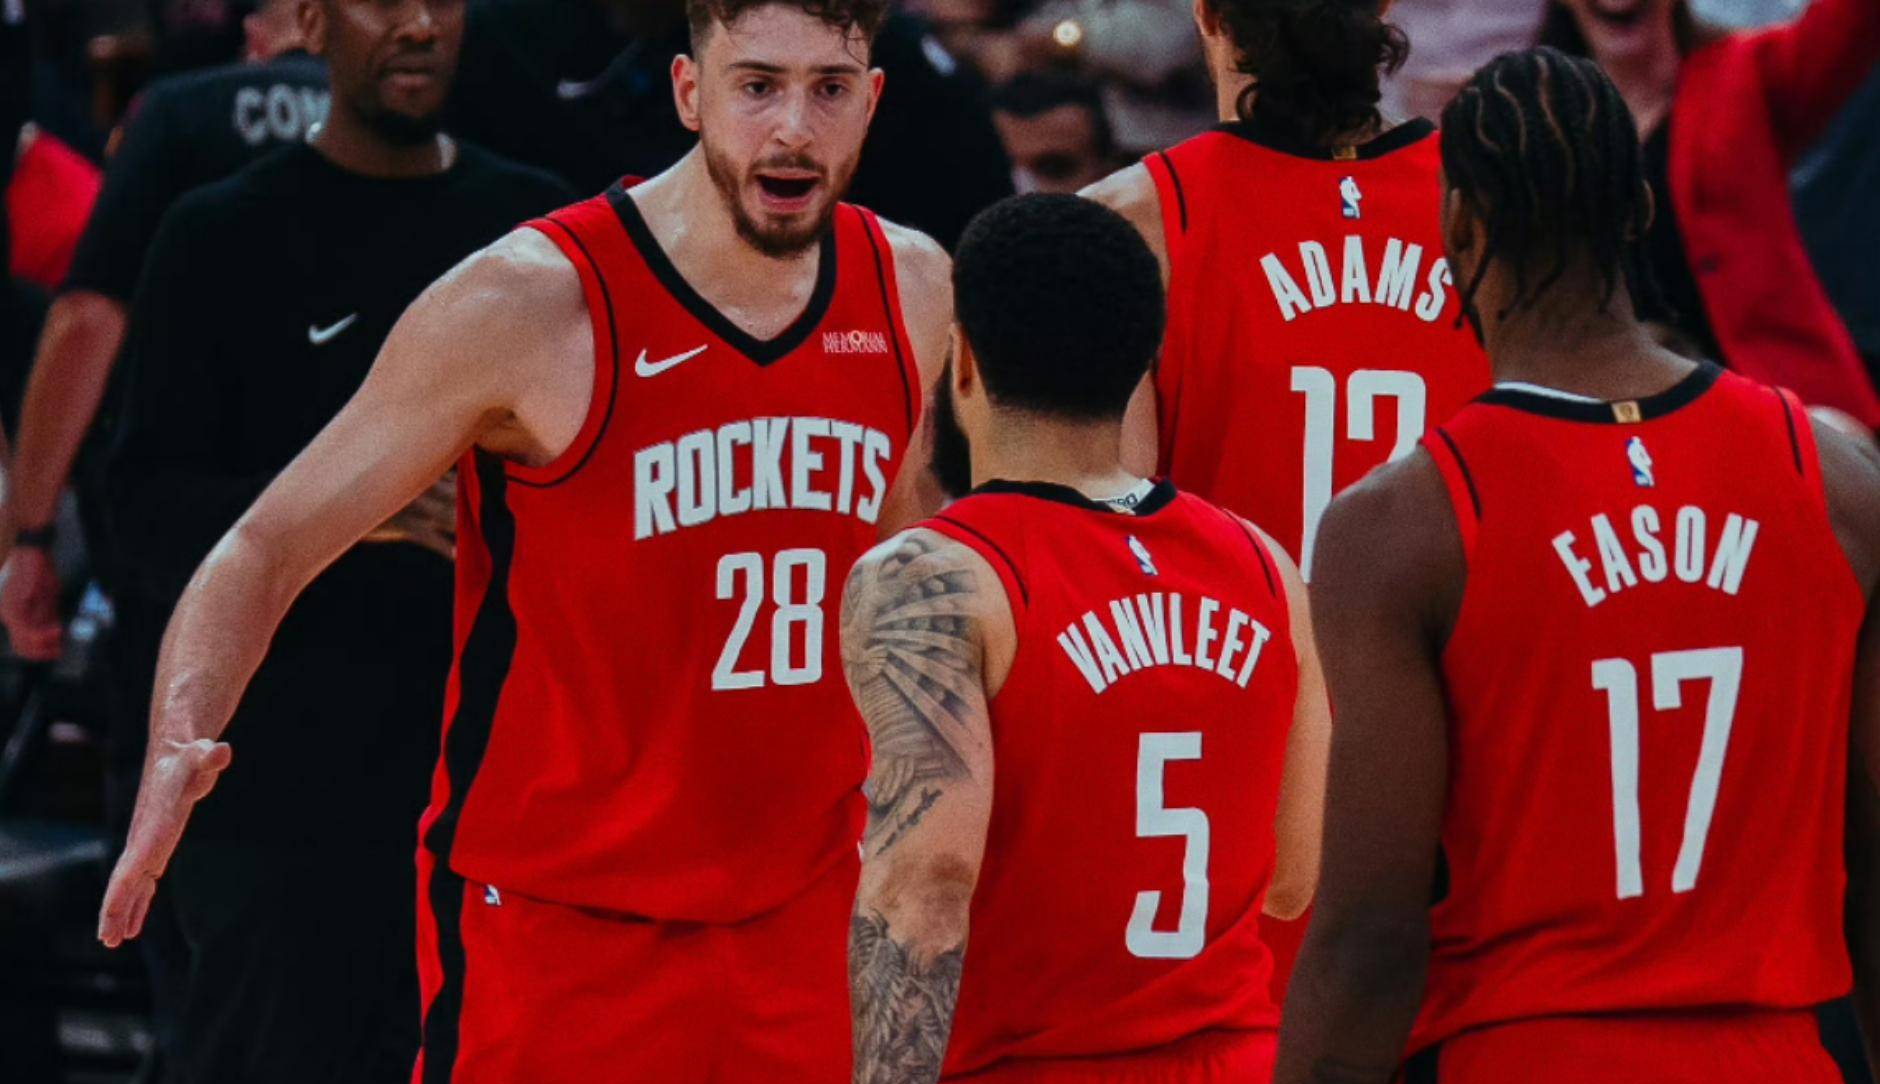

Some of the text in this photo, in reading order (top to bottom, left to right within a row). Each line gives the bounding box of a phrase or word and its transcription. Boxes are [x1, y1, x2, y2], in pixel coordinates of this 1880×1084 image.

[1259, 234, 1453, 322] ADAMS
[634, 416, 891, 541] ROCKETS
[1551, 504, 1759, 608] EASON
[711, 547, 826, 691] 28
[1056, 592, 1271, 694] VANVLEET
[1591, 646, 1743, 900] 17
[1125, 731, 1210, 959] 5
